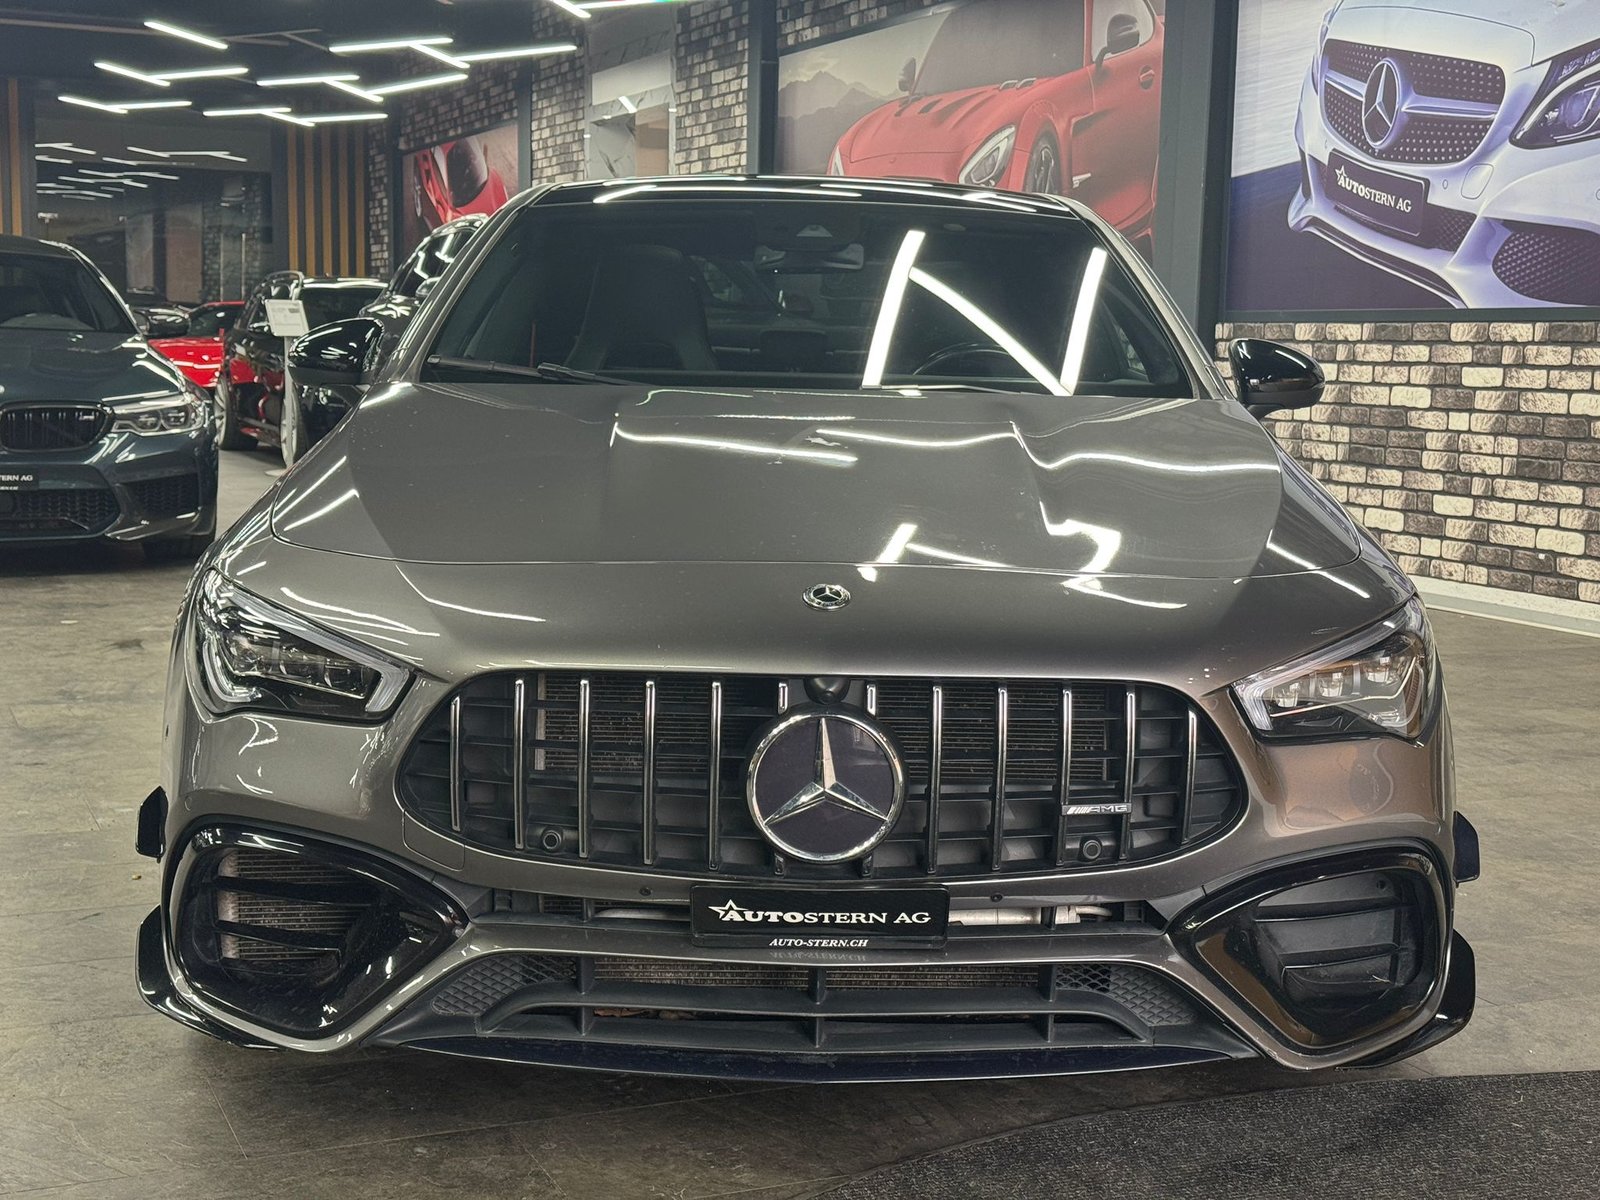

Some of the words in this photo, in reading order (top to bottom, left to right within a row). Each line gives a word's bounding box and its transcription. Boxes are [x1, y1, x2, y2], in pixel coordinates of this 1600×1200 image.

[1338, 175, 1395, 207] AUTOSTERN
[1396, 198, 1412, 213] AG
[721, 909, 887, 924] AUTOSTERN
[893, 912, 931, 924] AG
[769, 938, 868, 947] AUTO-STERN.CH
